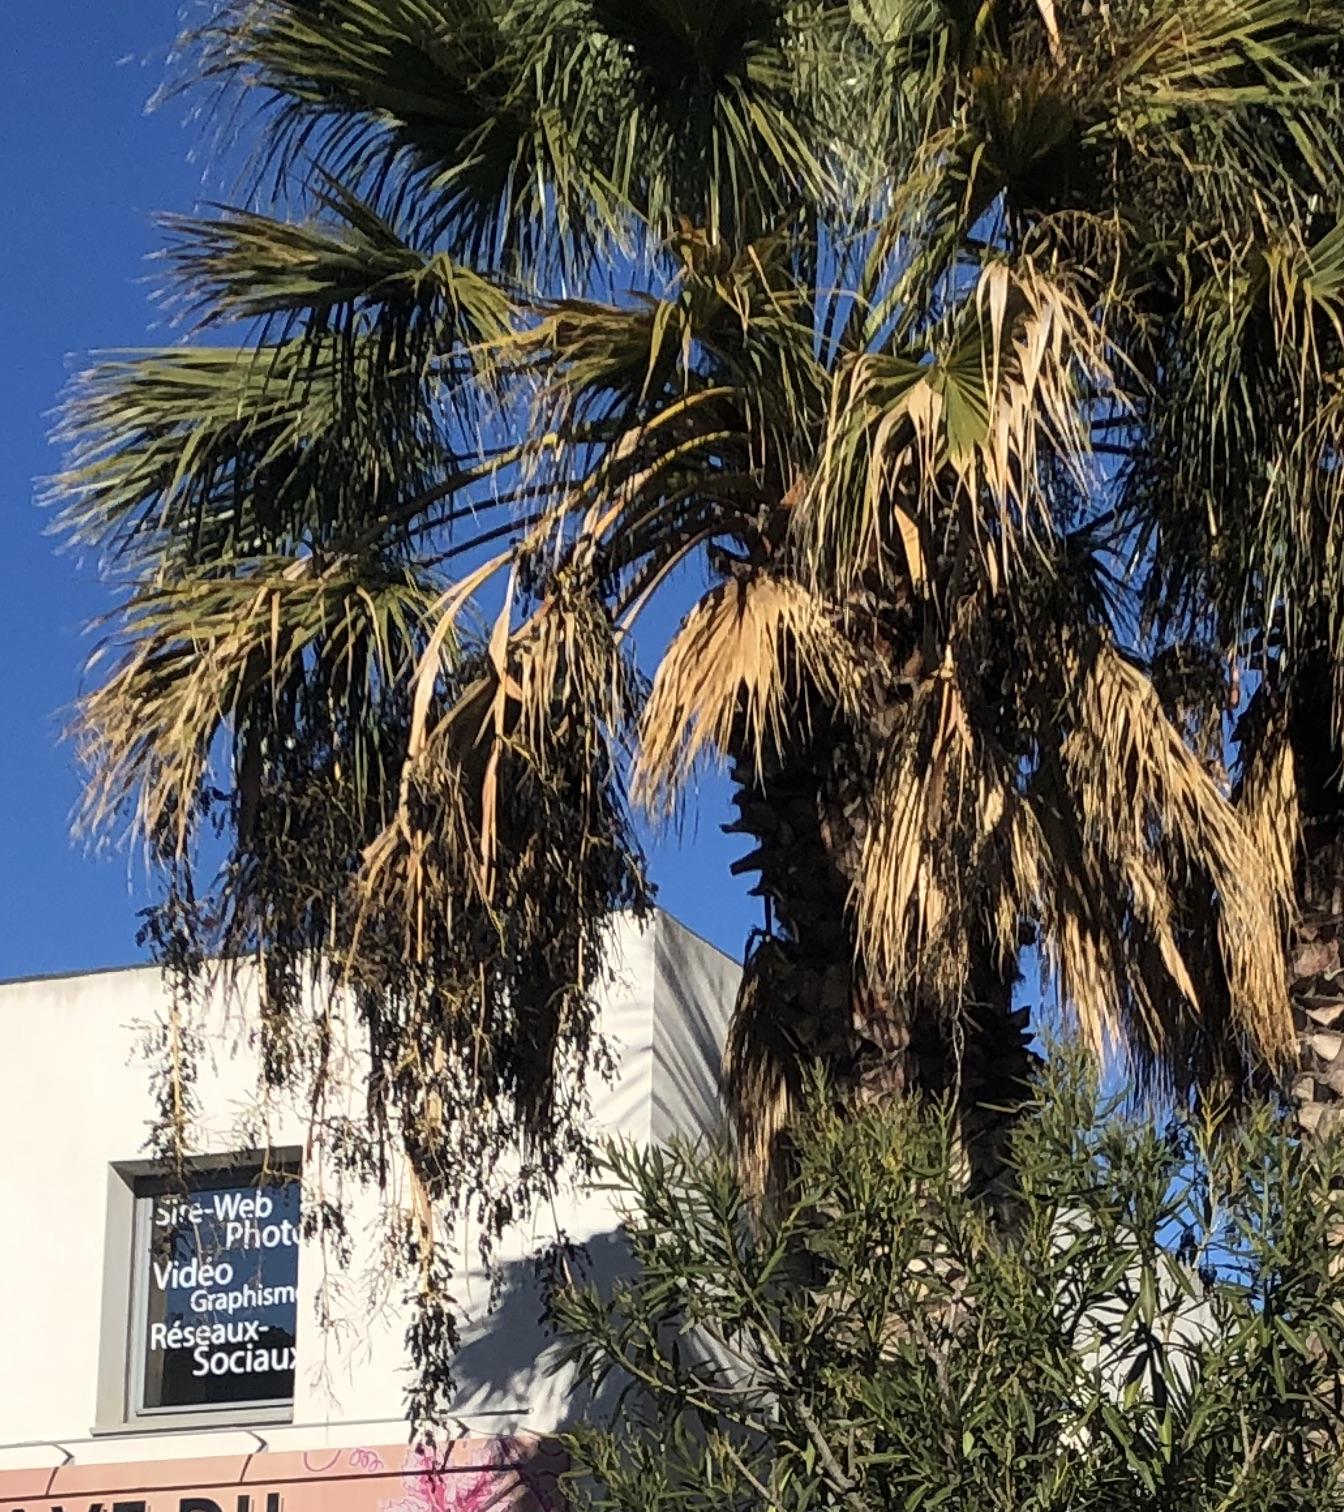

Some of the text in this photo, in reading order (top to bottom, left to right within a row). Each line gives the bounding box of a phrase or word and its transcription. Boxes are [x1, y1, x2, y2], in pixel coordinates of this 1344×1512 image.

[153, 1256, 234, 1291] Vidéo
[190, 1283, 299, 1315] Graphism
[151, 1319, 270, 1350] Réseaux-
